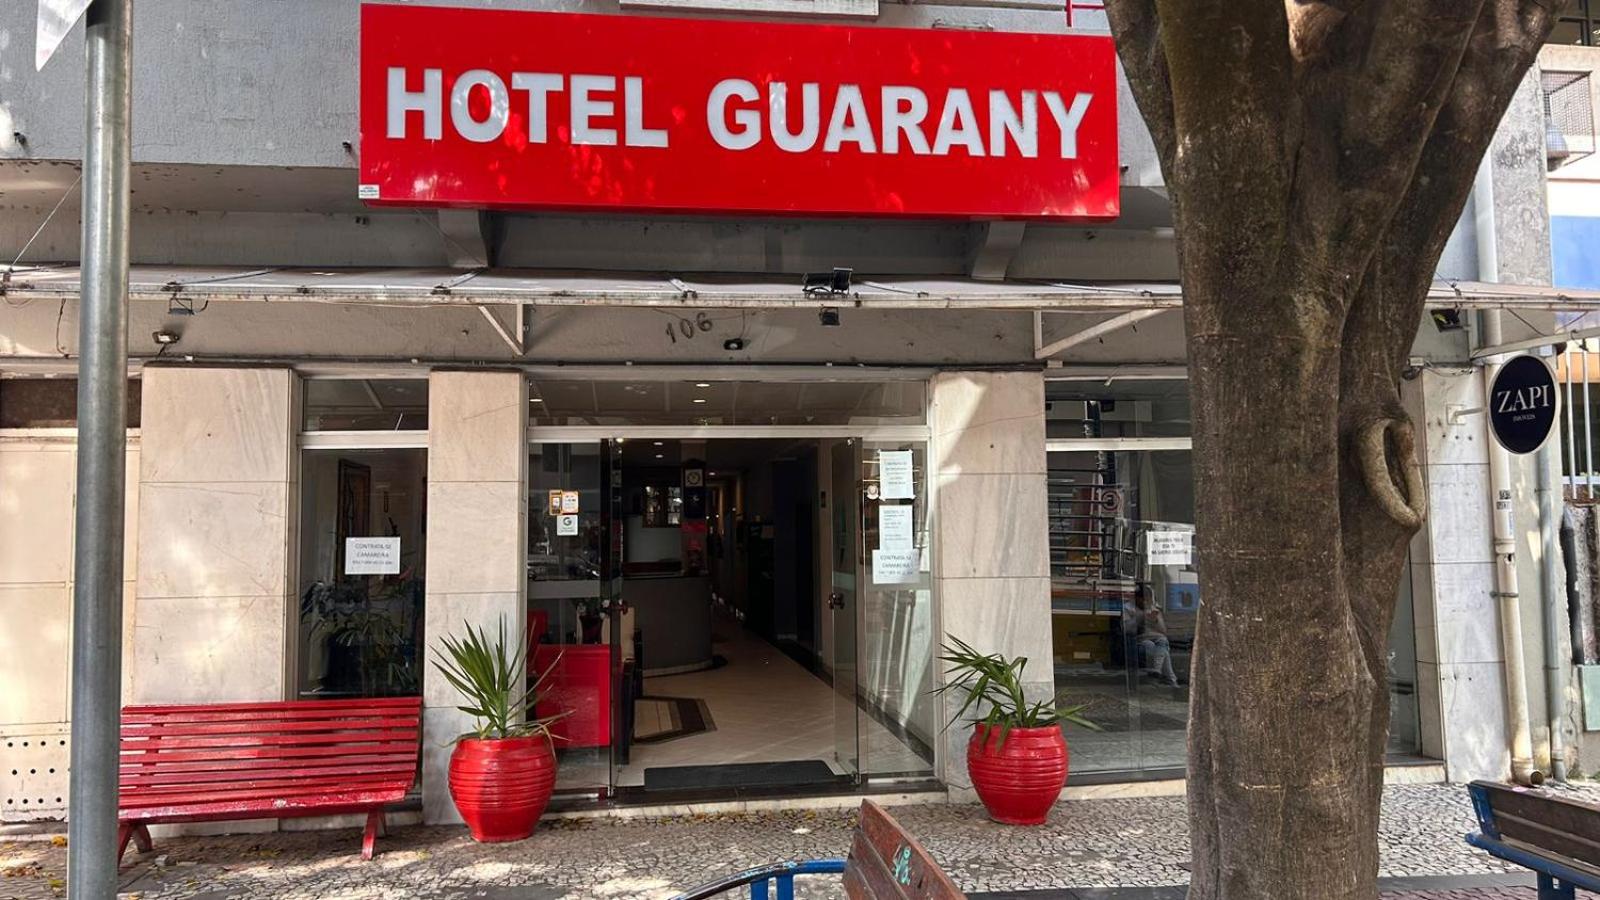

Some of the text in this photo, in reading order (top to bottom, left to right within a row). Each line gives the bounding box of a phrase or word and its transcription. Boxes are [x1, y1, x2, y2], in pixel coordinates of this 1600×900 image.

[386, 67, 1094, 159] HOTEL GUARANY
[665, 312, 713, 344] 106
[1497, 384, 1550, 413] ZAPI
